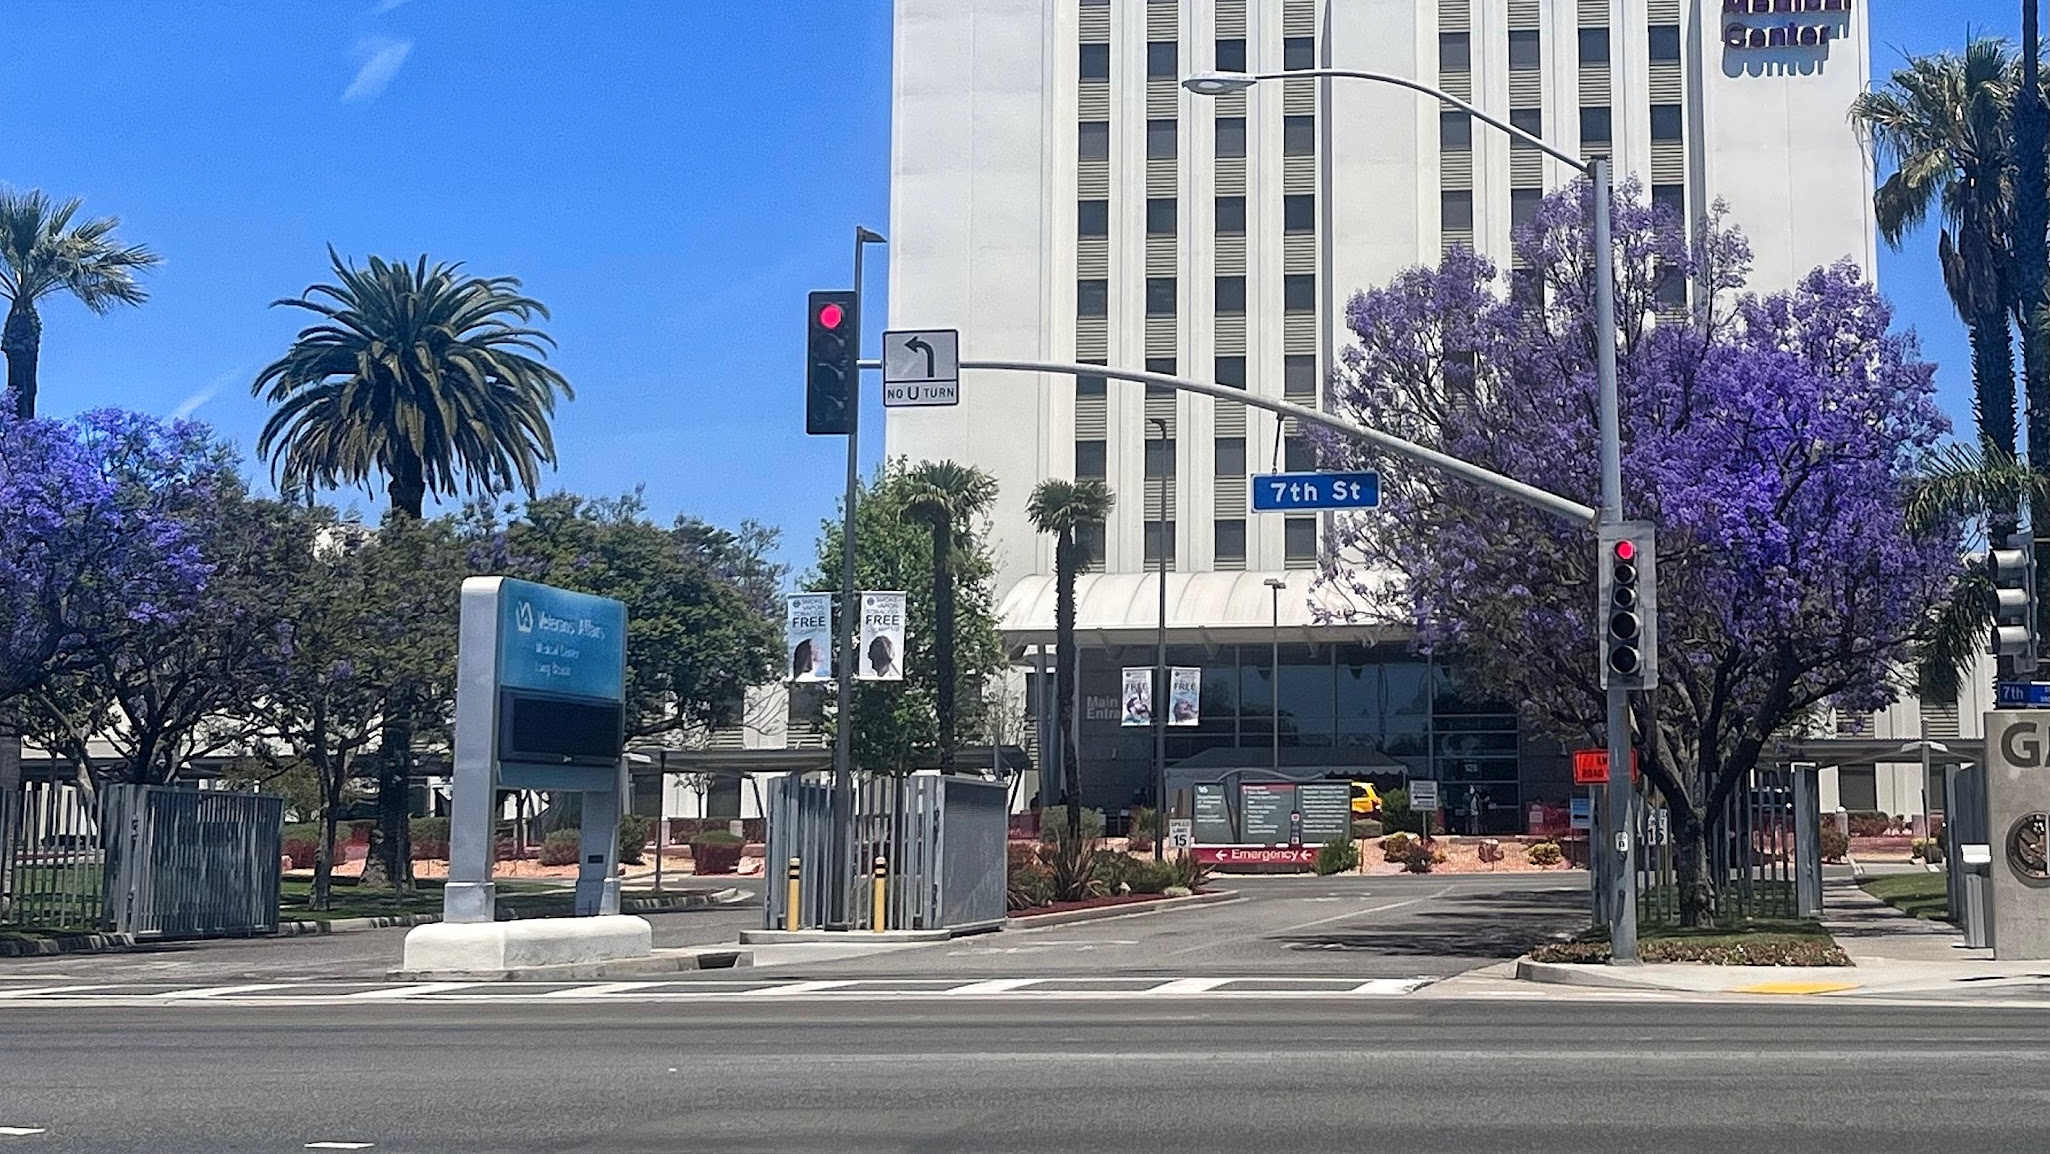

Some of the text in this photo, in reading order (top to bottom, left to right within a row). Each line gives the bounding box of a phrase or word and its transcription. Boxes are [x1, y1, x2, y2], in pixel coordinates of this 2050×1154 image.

[1725, 22, 1831, 49] Center
[887, 386, 954, 400] NO U TURN
[1270, 480, 1361, 502] 7th St
[792, 616, 826, 628] FREE
[865, 615, 900, 626] FREE
[2003, 686, 2024, 700] 7th
[1086, 696, 1118, 708] Main
[1086, 707, 1121, 719] Entra
[1174, 834, 1187, 846] 15
[1231, 849, 1298, 861] Emergency
